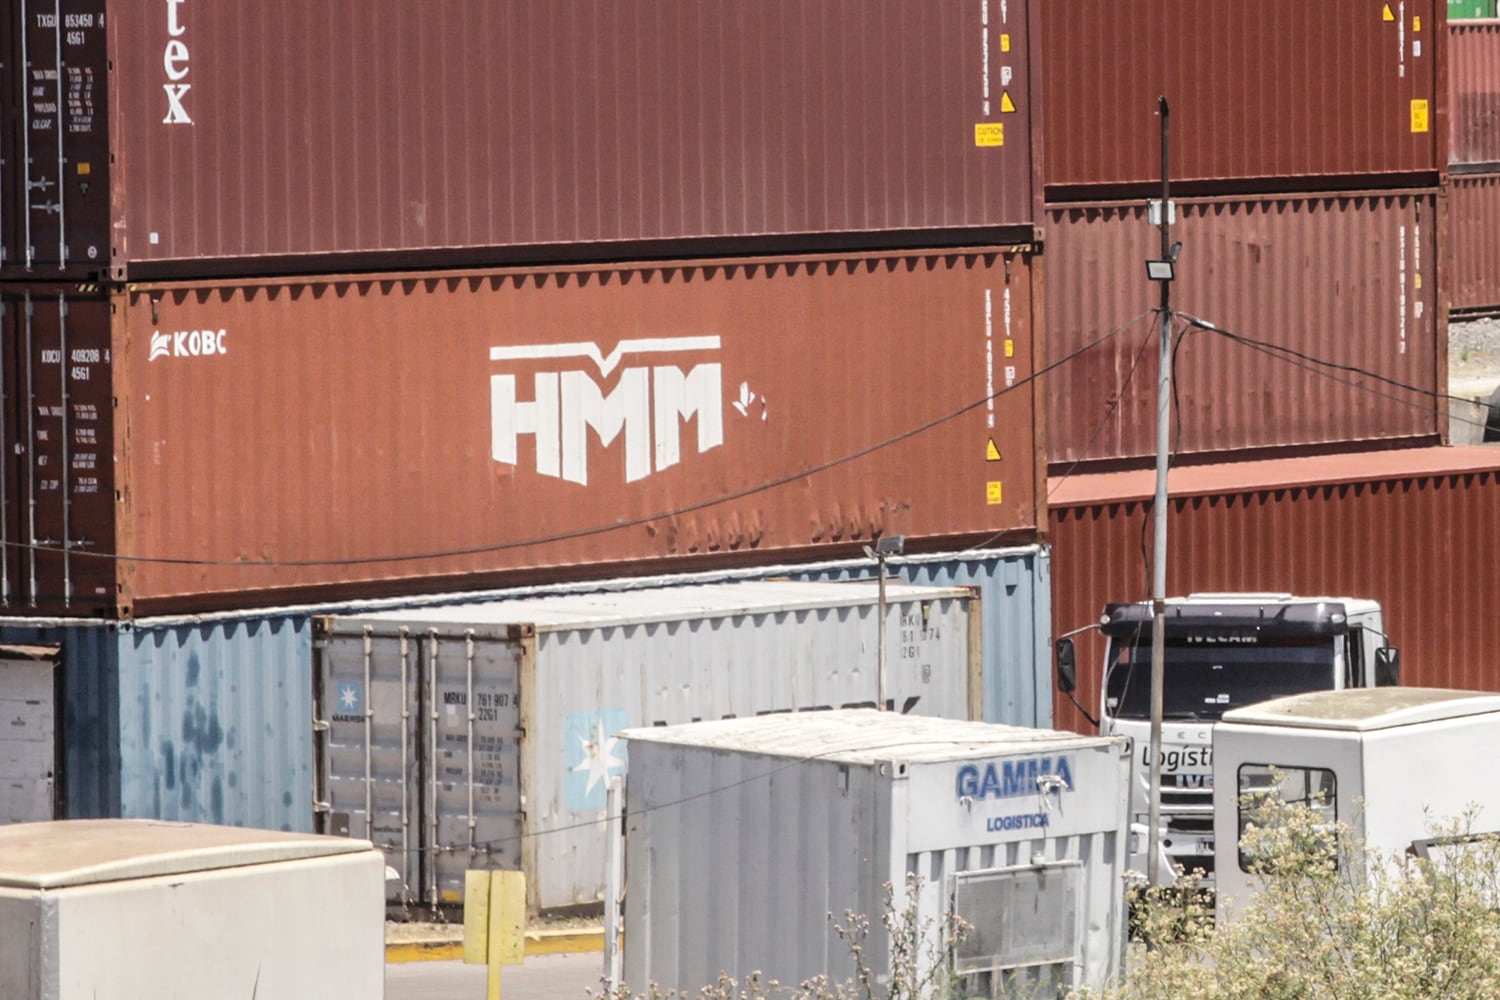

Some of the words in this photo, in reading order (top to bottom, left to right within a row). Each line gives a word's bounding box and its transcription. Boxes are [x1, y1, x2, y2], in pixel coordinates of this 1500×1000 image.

[65, 14, 93, 28] 853450
[67, 31, 85, 46] 45G1
[174, 329, 227, 357] KOBC
[42, 350, 60, 363] KOCU
[71, 350, 99, 363] 409206
[71, 367, 90, 380] 45G1
[490, 336, 723, 486] HMM
[444, 692, 467, 704] MRKU
[478, 708, 498, 721] 22G1
[956, 755, 1075, 800] GAMMA
[987, 813, 1050, 832] LOGISTICA
